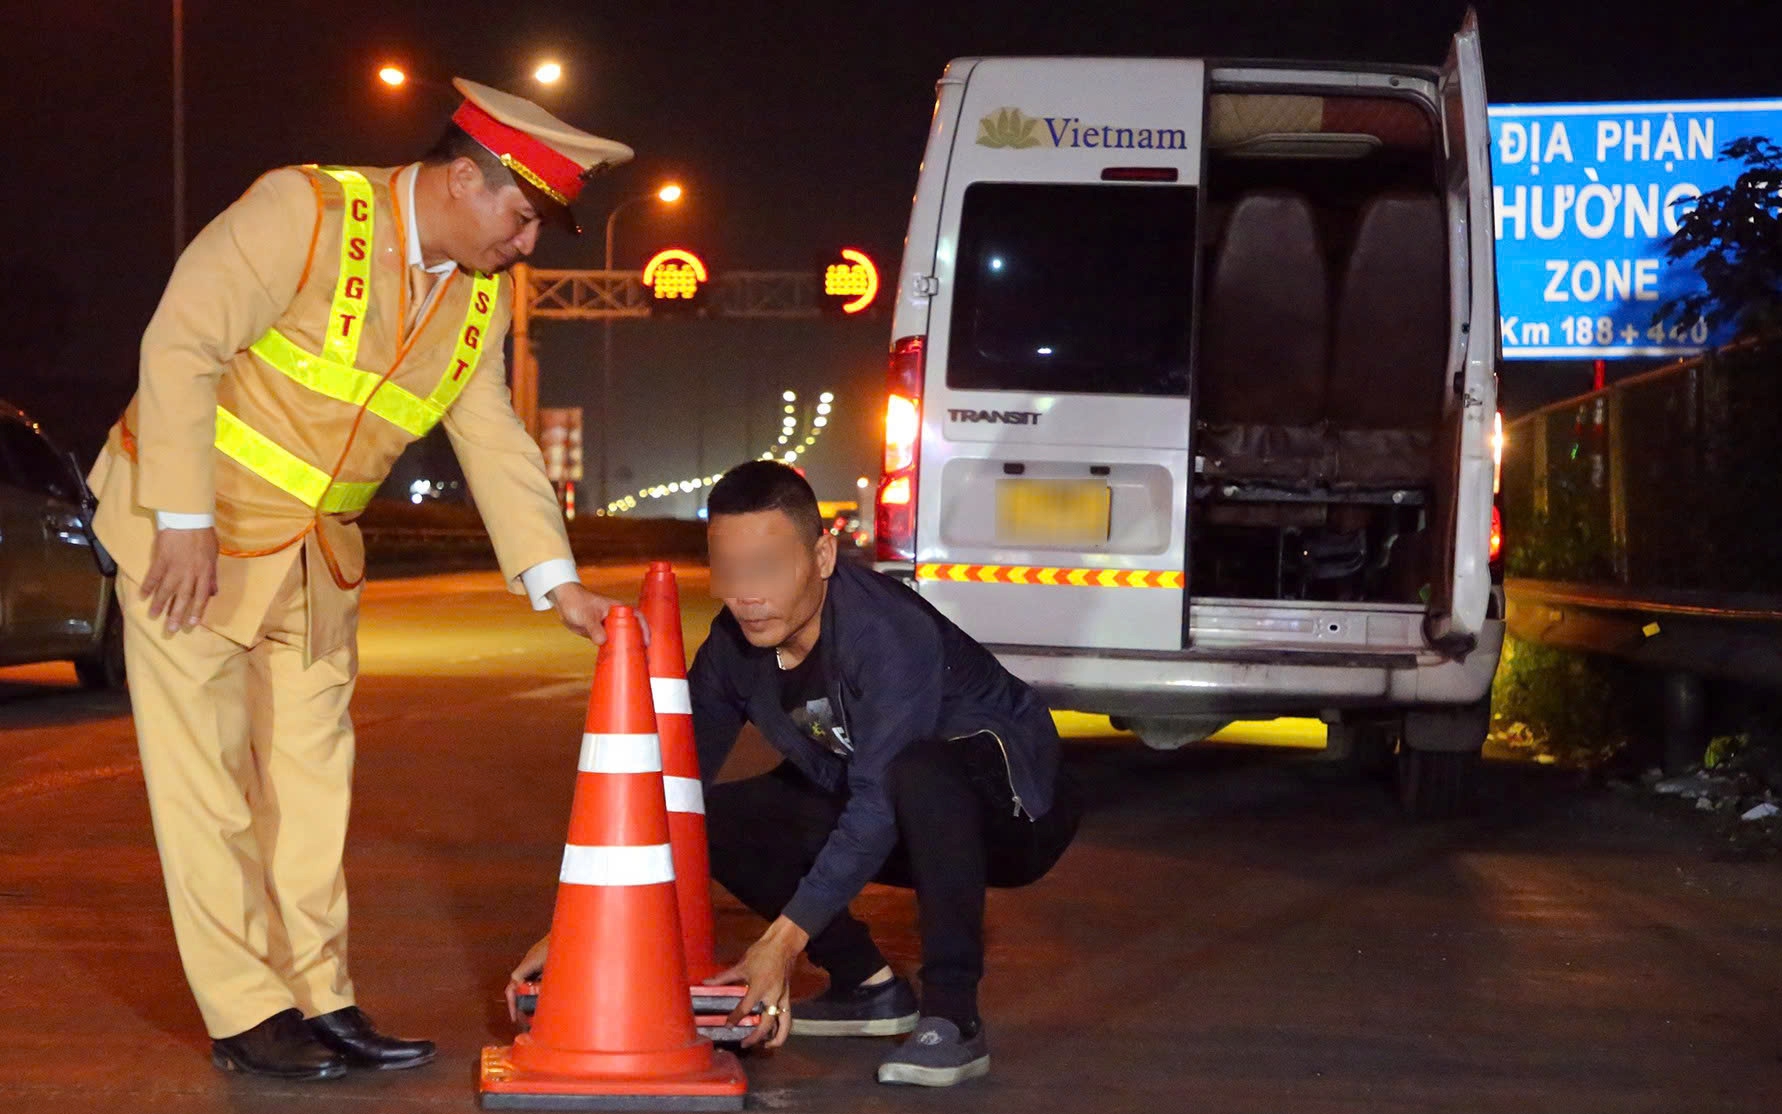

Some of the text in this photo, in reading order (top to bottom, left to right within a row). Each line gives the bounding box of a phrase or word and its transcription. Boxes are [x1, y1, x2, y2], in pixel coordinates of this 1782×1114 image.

[1043, 117, 1188, 150] Vietnam
[1498, 111, 1715, 176] ĐỊA PHẬN
[1493, 167, 1704, 241] HƯỜNG
[339, 199, 369, 337] CSGT
[1543, 258, 1660, 303] ZONE
[452, 272, 494, 382] SGT
[1500, 315, 1550, 346] Km
[1560, 315, 1614, 346] 188
[947, 408, 1043, 426] TRANSIT
